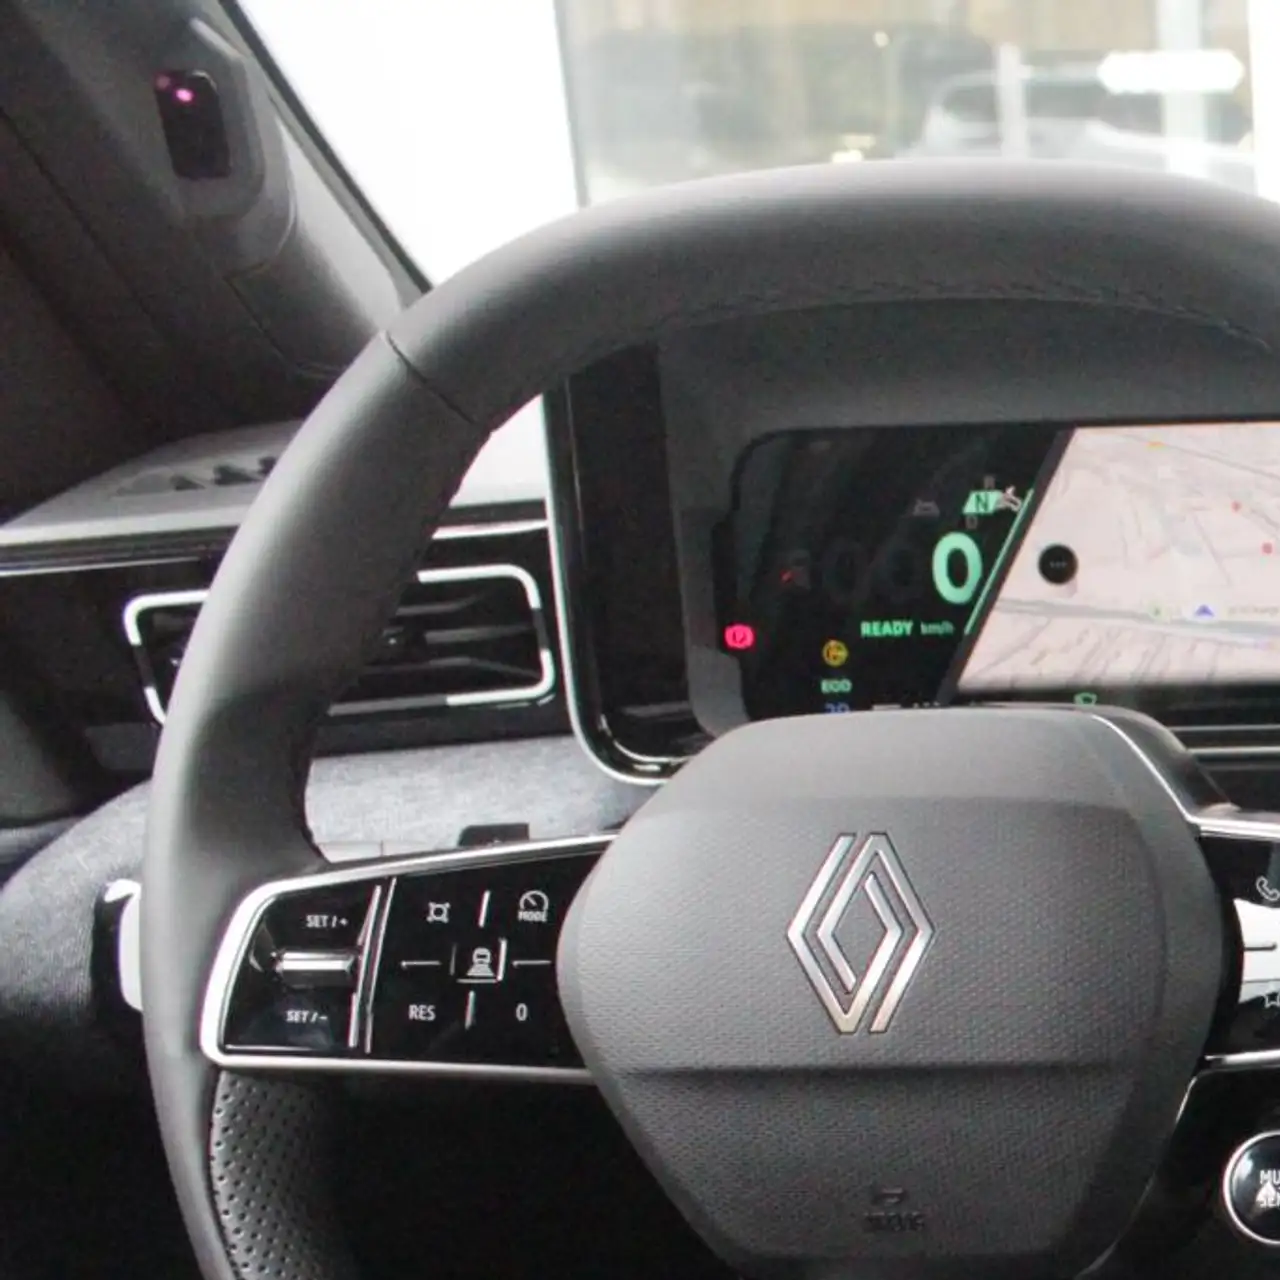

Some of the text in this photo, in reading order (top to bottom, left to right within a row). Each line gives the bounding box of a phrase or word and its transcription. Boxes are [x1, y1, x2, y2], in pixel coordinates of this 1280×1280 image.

[975, 492, 989, 512] N
[931, 531, 983, 604] 0
[860, 621, 954, 637] READY km/h
[408, 1004, 436, 1021] RES
